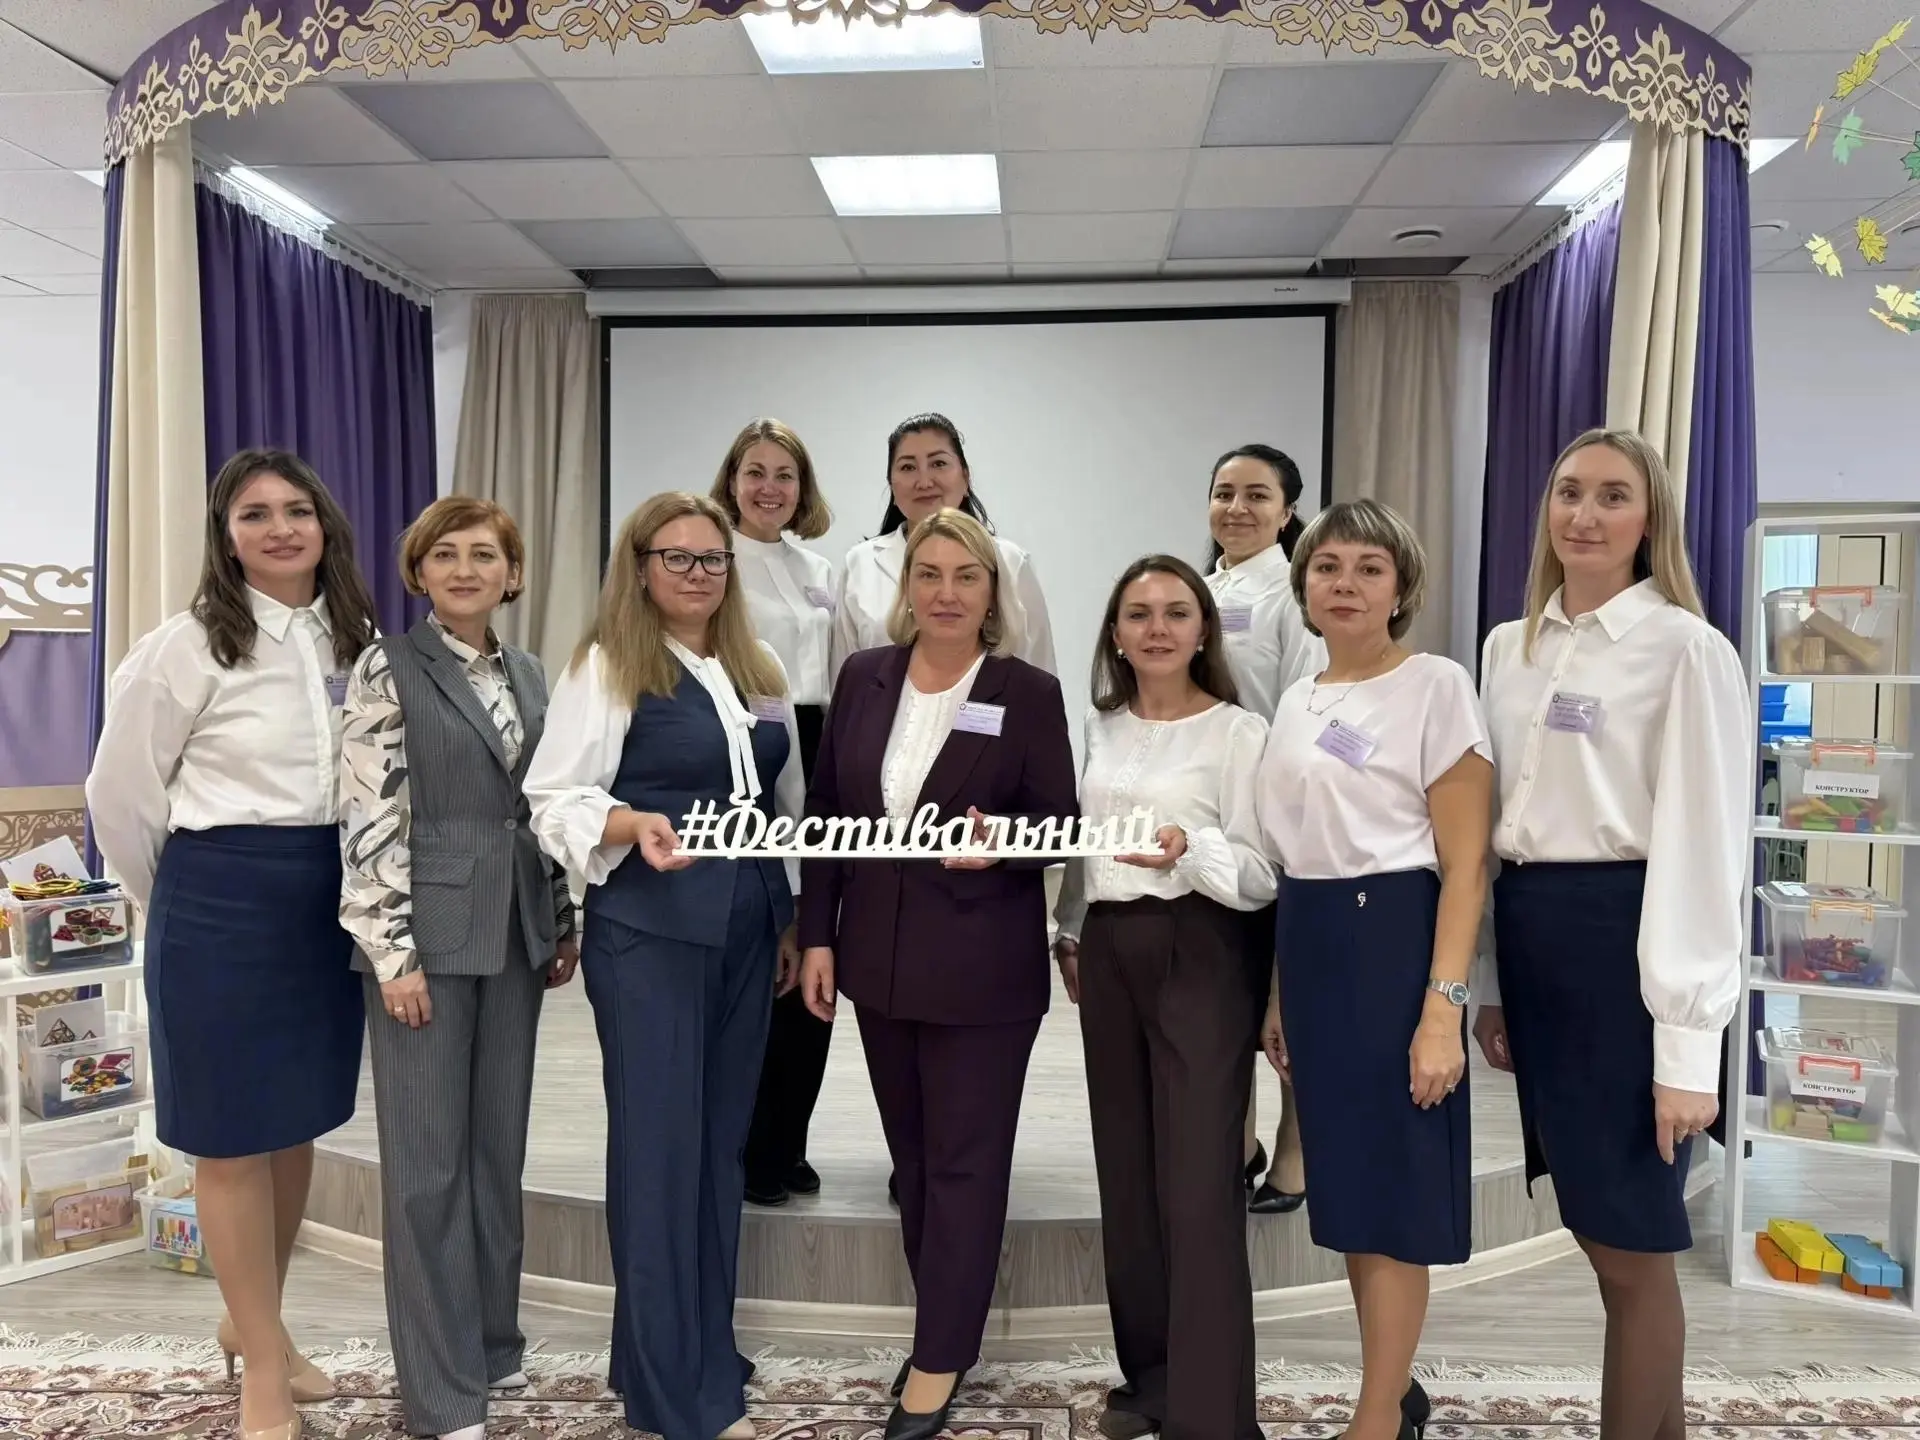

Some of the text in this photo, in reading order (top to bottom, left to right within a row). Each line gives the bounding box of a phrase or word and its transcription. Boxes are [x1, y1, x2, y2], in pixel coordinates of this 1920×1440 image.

[1815, 784, 1869, 794] КОНСТРУКТОР
[677, 798, 1162, 859] #Фестивальный
[1803, 1082, 1856, 1095] КОНСТРУКТОР
